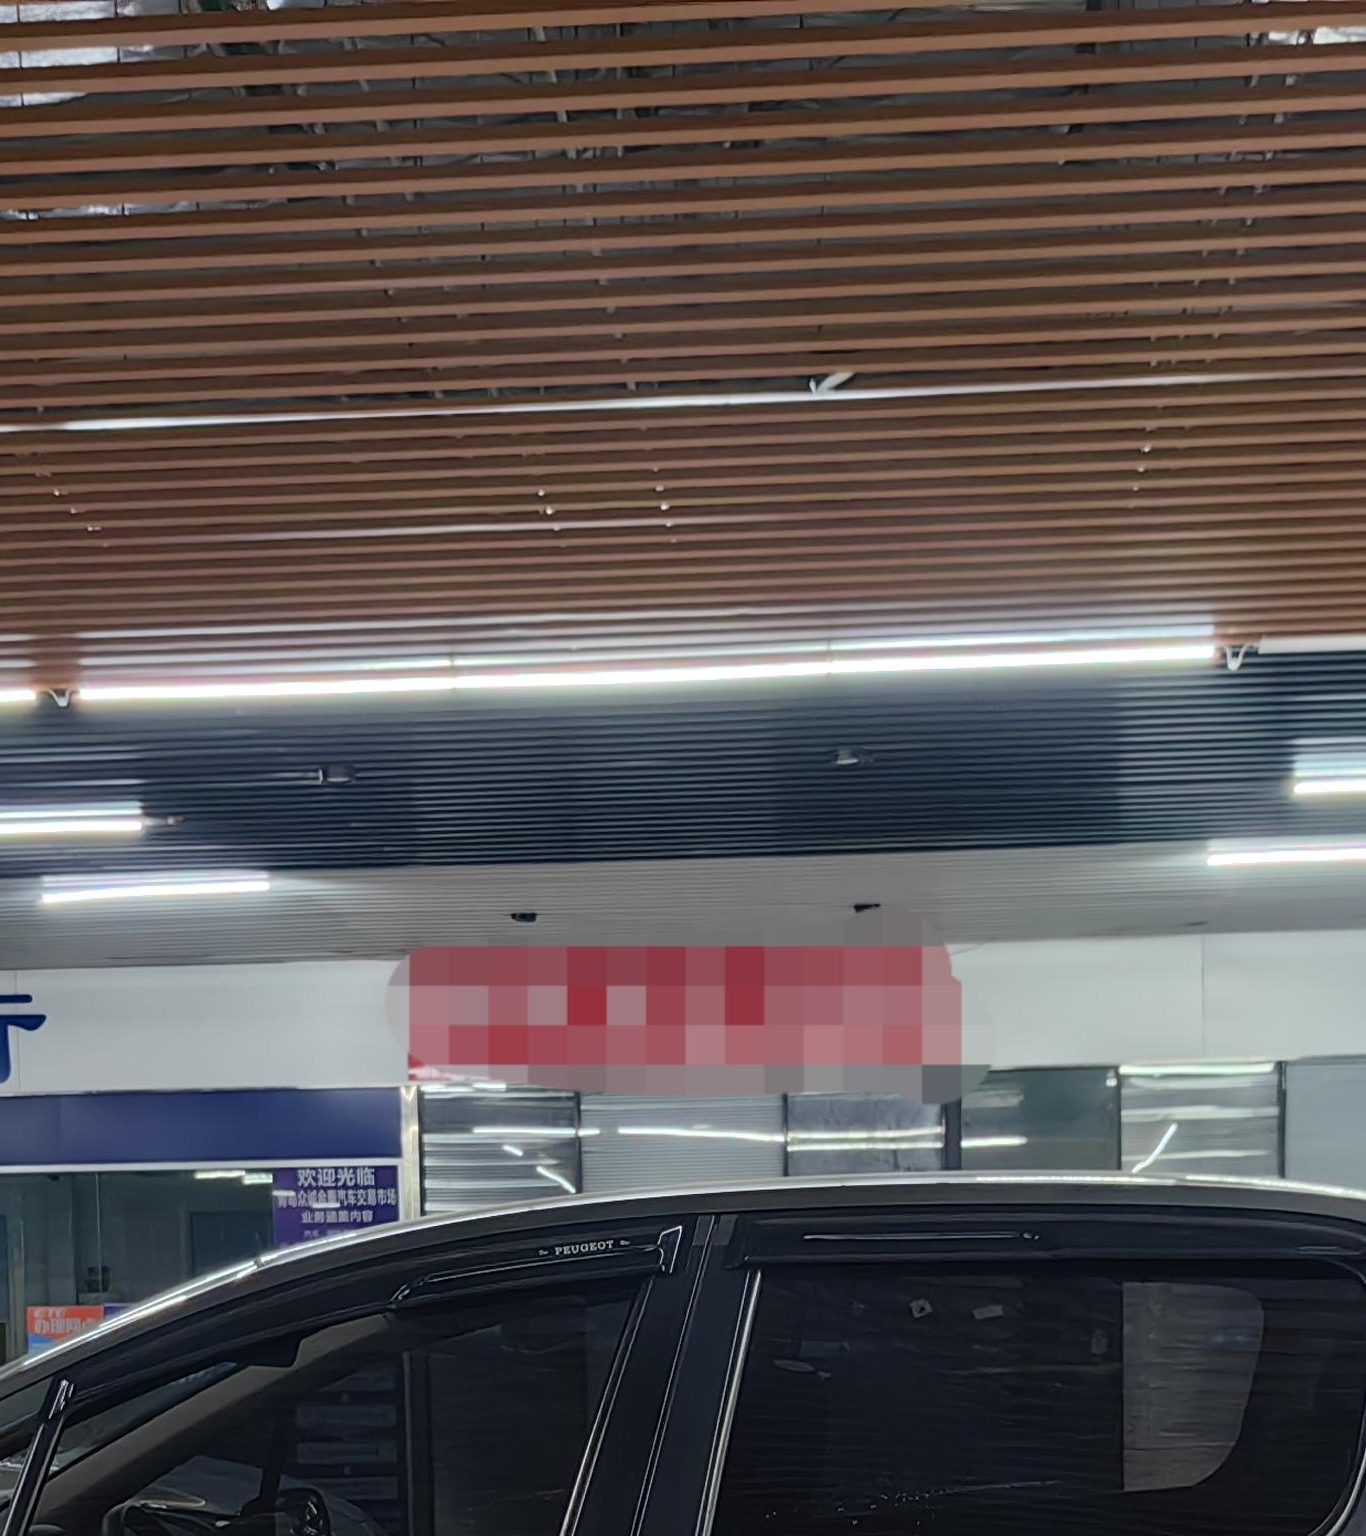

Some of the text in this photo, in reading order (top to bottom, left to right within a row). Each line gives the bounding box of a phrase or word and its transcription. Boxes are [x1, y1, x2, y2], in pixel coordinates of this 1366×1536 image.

[297, 1166, 376, 1188] 欢迎光临
[555, 1239, 615, 1256] PEUGEOT
